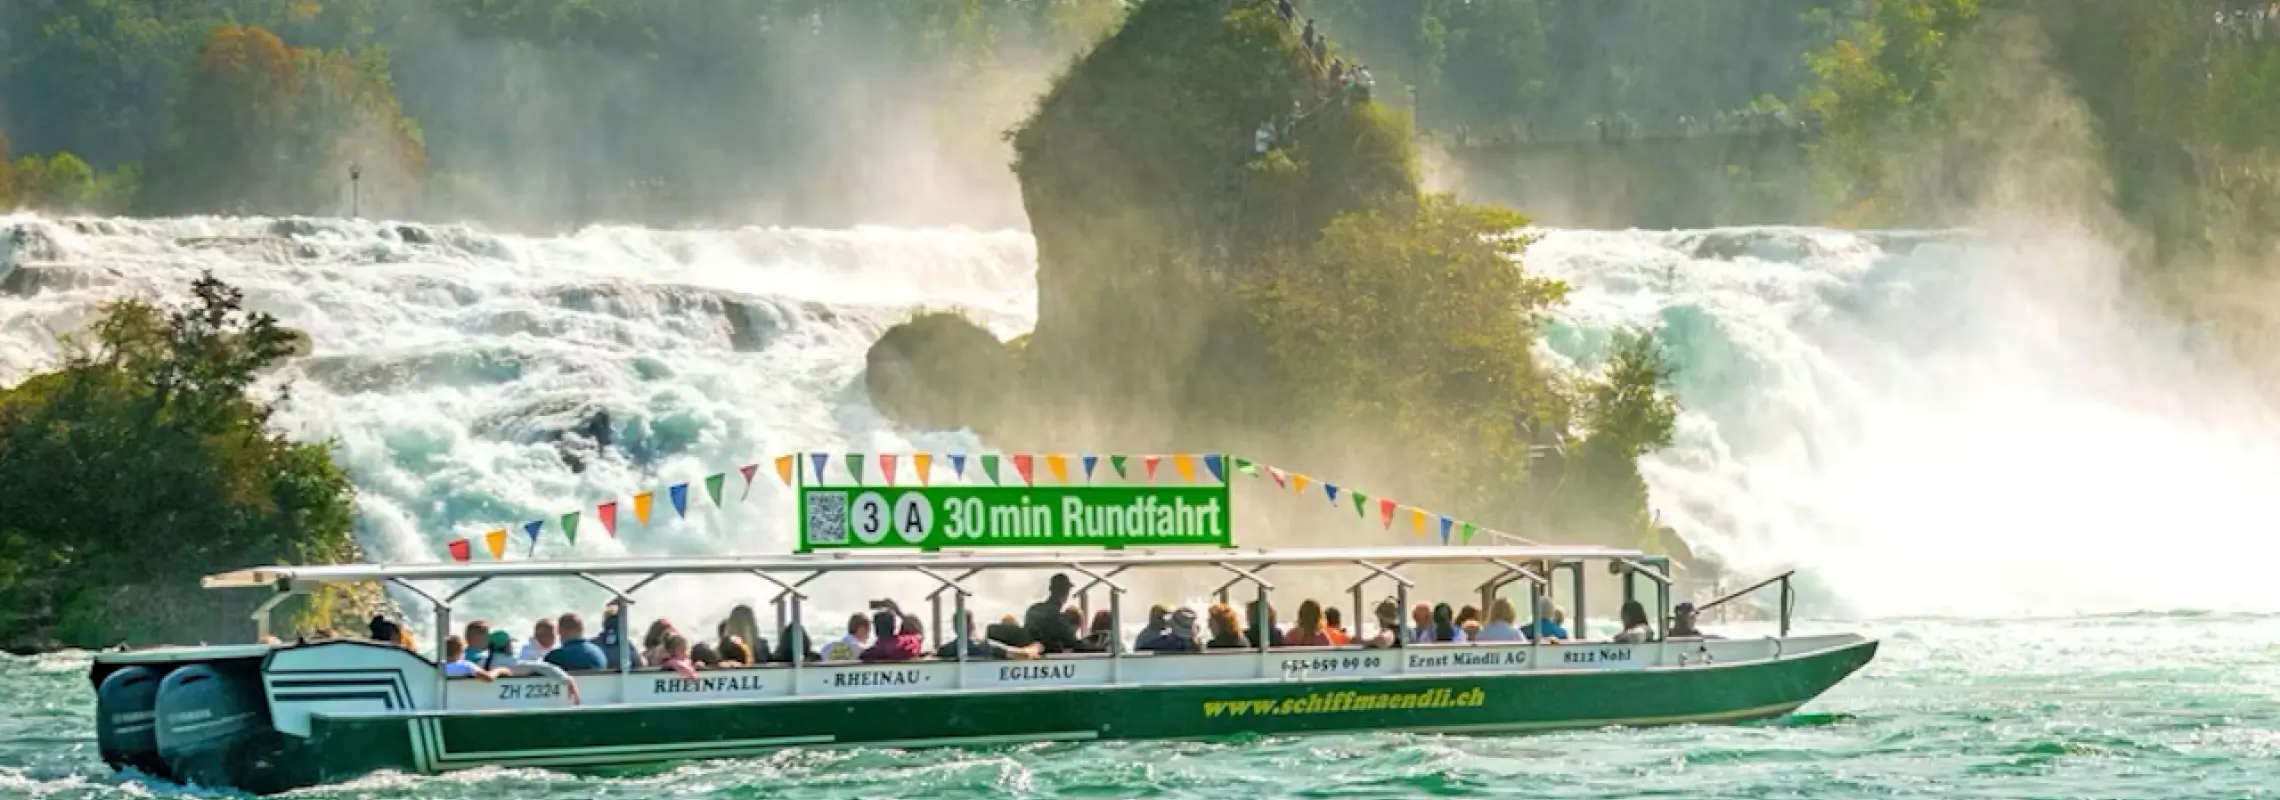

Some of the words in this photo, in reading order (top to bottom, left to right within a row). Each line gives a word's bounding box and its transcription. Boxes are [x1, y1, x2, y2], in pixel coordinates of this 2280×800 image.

[863, 501, 879, 534] 3
[904, 501, 924, 534] A
[943, 498, 984, 537] 30
[990, 497, 1051, 537] min
[1061, 497, 1220, 537] Rundfahrt
[1408, 654, 1447, 668] Ernst
[1453, 651, 1500, 665] Mändli
[1505, 651, 1526, 665] AG
[1600, 648, 1631, 661] Nohl
[1313, 656, 1338, 671] 659
[834, 670, 920, 688] RHEINAU
[999, 664, 1077, 681] EGLISAU
[499, 684, 521, 699] ZH
[525, 683, 560, 698] 2324
[654, 675, 764, 694] RHEINFALL
[1203, 687, 1485, 717] www.schiffmaendli.ch
